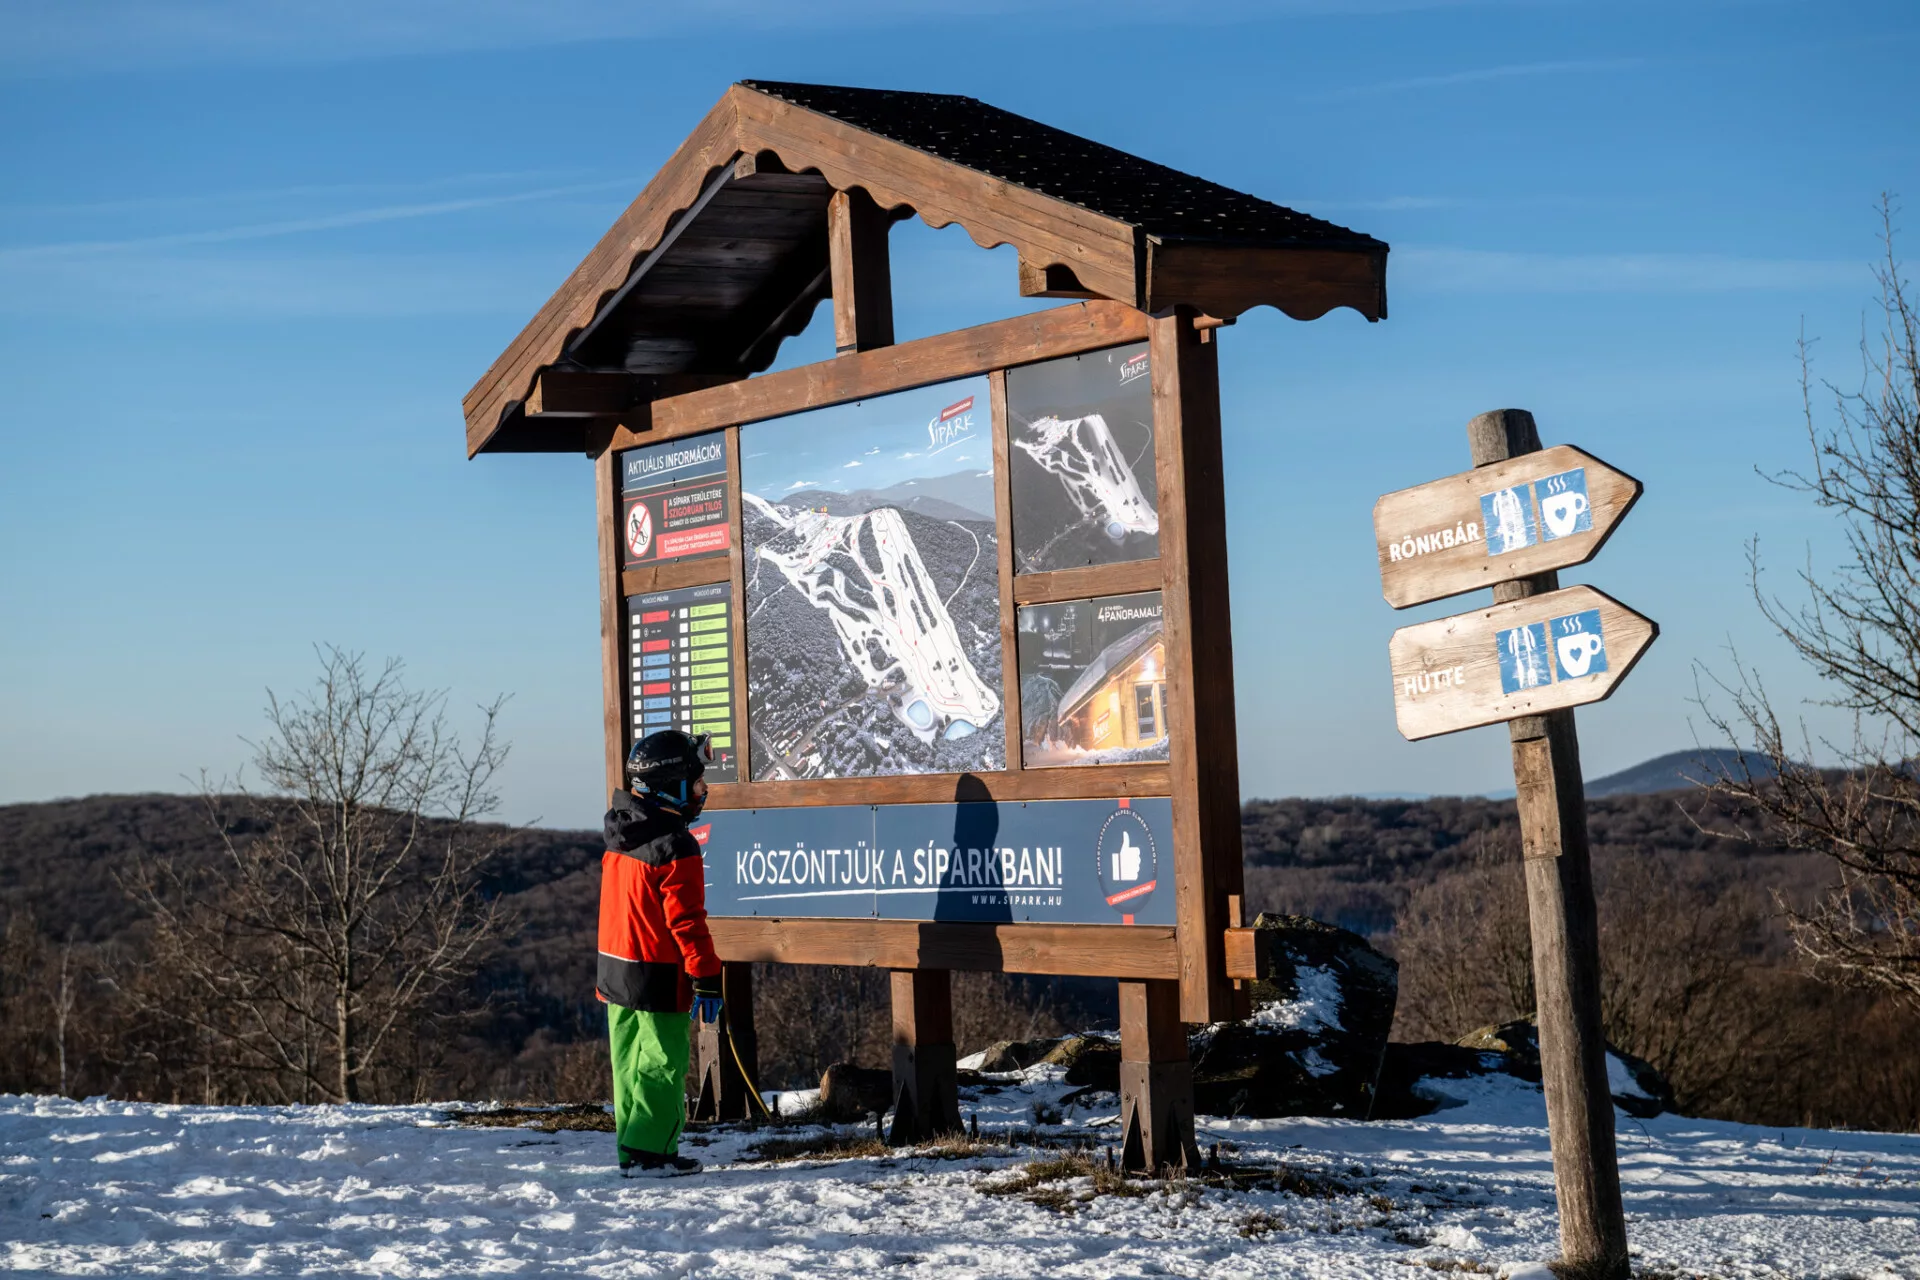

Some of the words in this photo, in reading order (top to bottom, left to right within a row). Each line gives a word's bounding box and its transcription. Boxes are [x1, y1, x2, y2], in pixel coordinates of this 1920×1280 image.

[628, 455, 664, 476] AKTUÁLIS
[665, 442, 722, 468] INFORMÁCIÓK
[691, 489, 722, 503] TERÜLETÉRE
[705, 500, 723, 512] TILOS
[1389, 521, 1480, 562] RÖNKBÁR
[1403, 666, 1465, 696] HÜTTE
[736, 841, 885, 886] KÖSZÖNTJÜK
[891, 852, 907, 884] A
[913, 840, 1062, 886] SÍPARKBAN!
[971, 894, 1062, 906] WWW.SIPARK.HU
